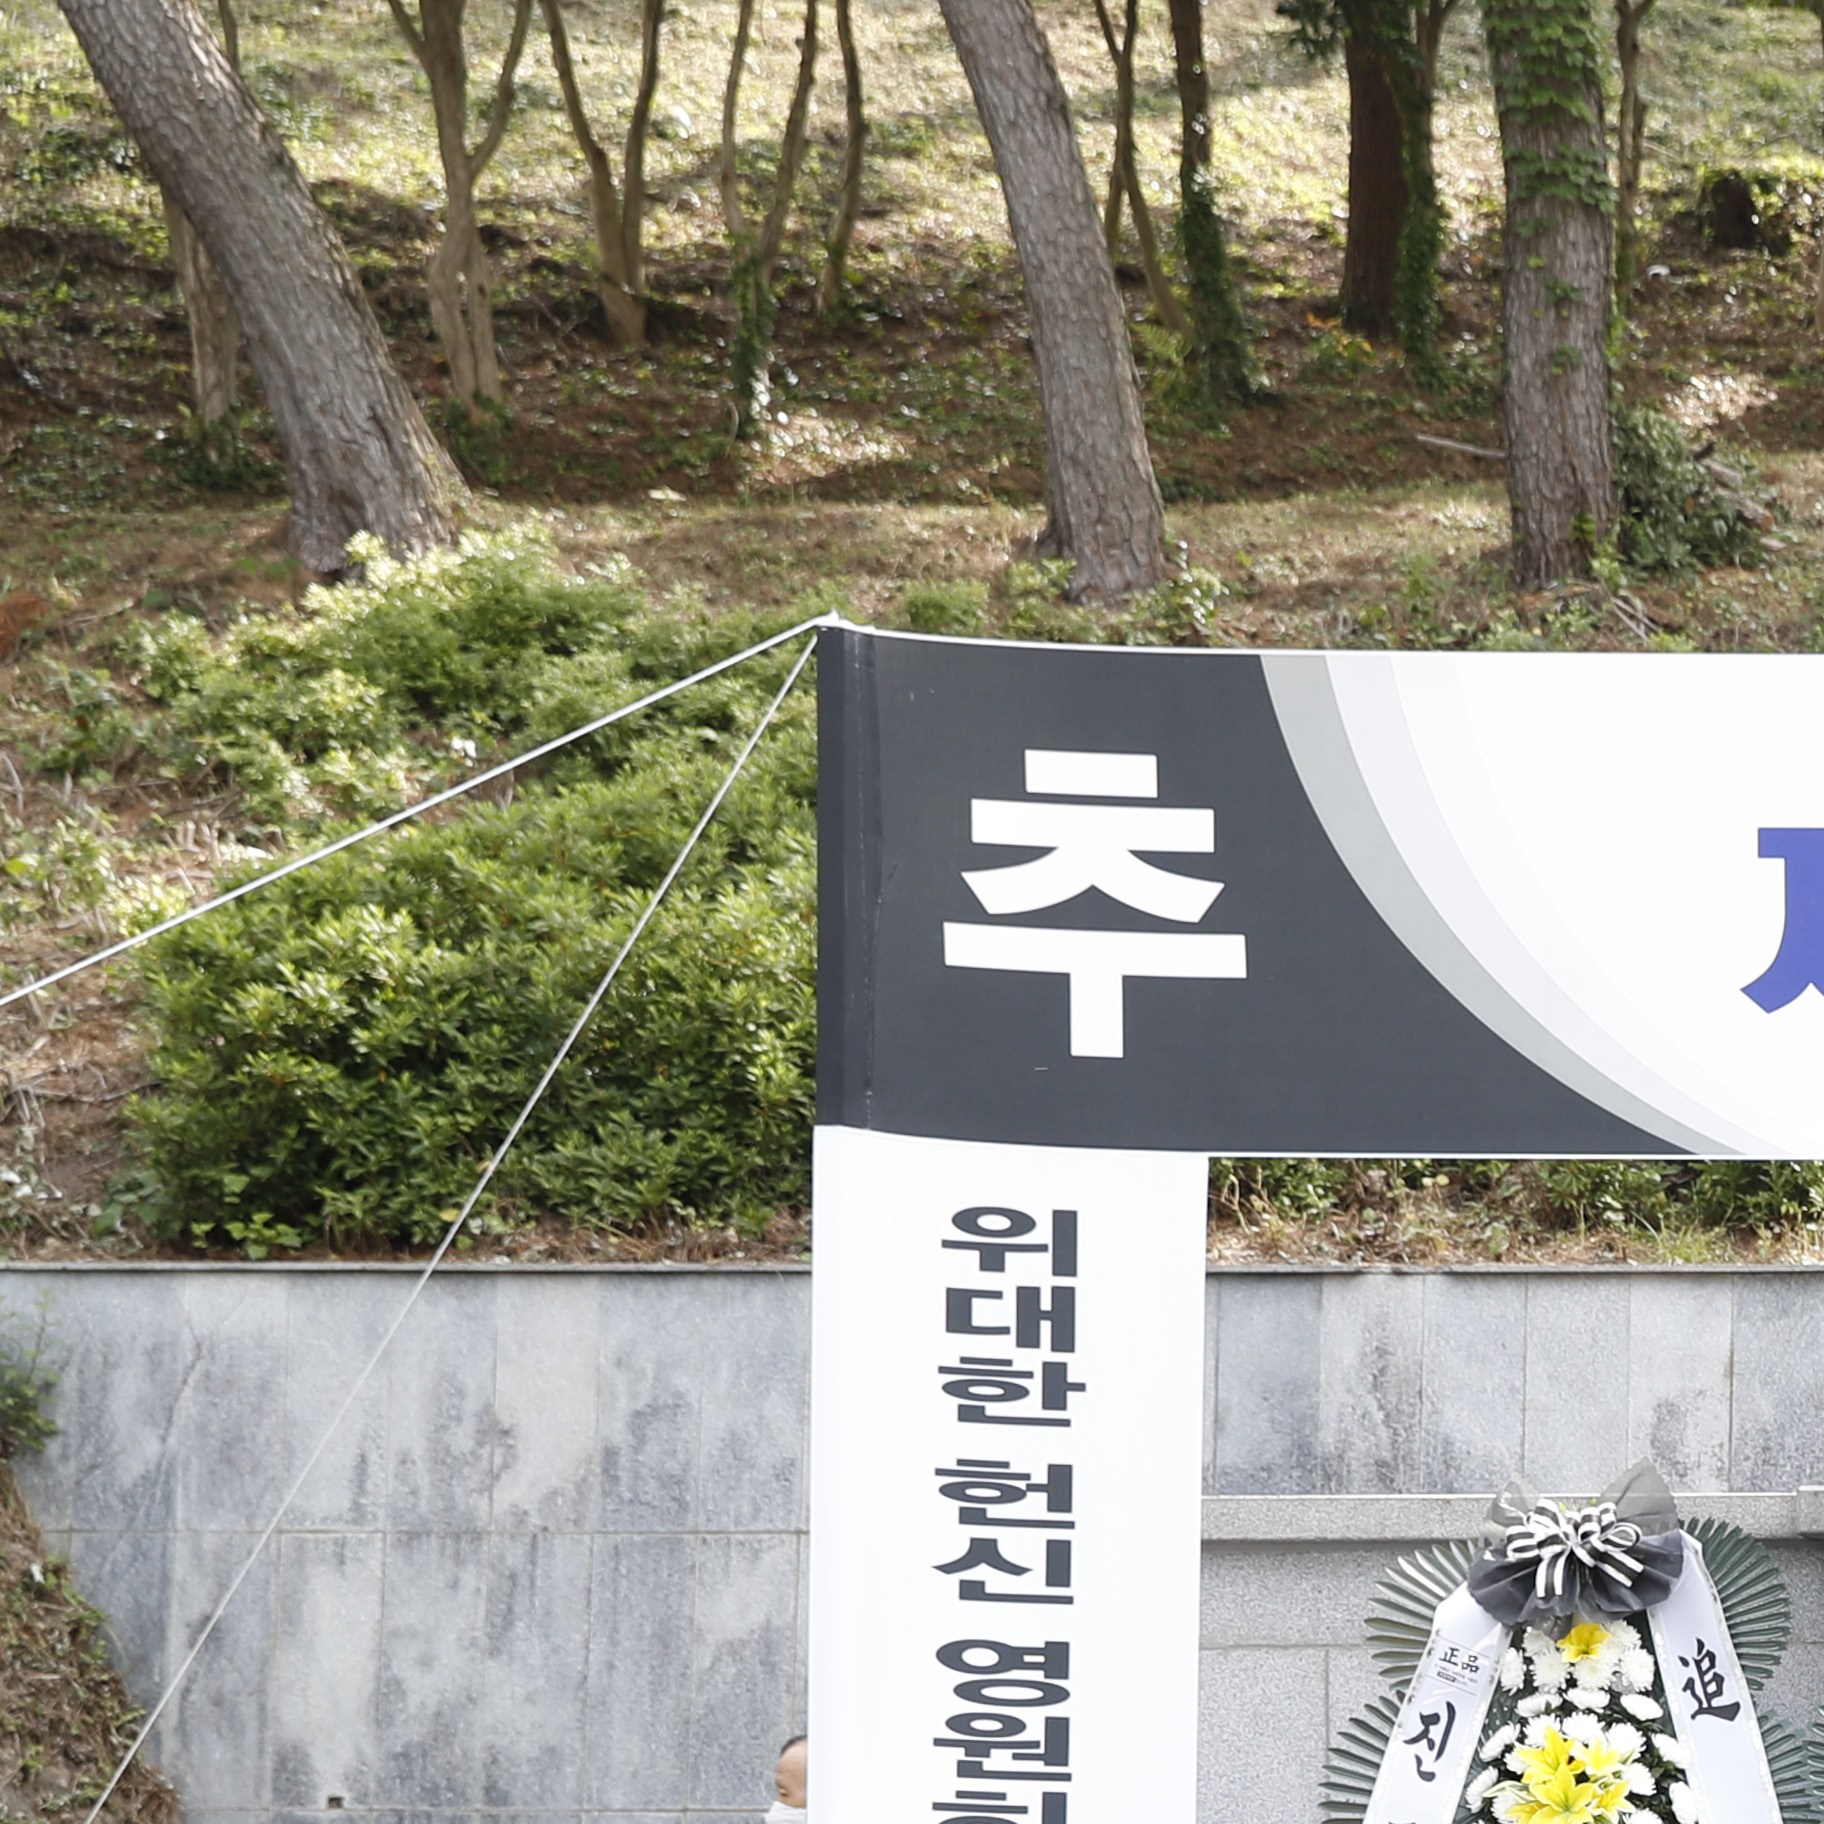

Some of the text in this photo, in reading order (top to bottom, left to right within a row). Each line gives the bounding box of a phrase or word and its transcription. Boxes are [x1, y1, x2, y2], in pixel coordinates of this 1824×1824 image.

[943, 749, 1247, 1058] 추
[937, 1206, 1086, 1428] 위대한
[932, 1458, 1076, 1605] 헌신
[1438, 1646, 1480, 1674] 正品
